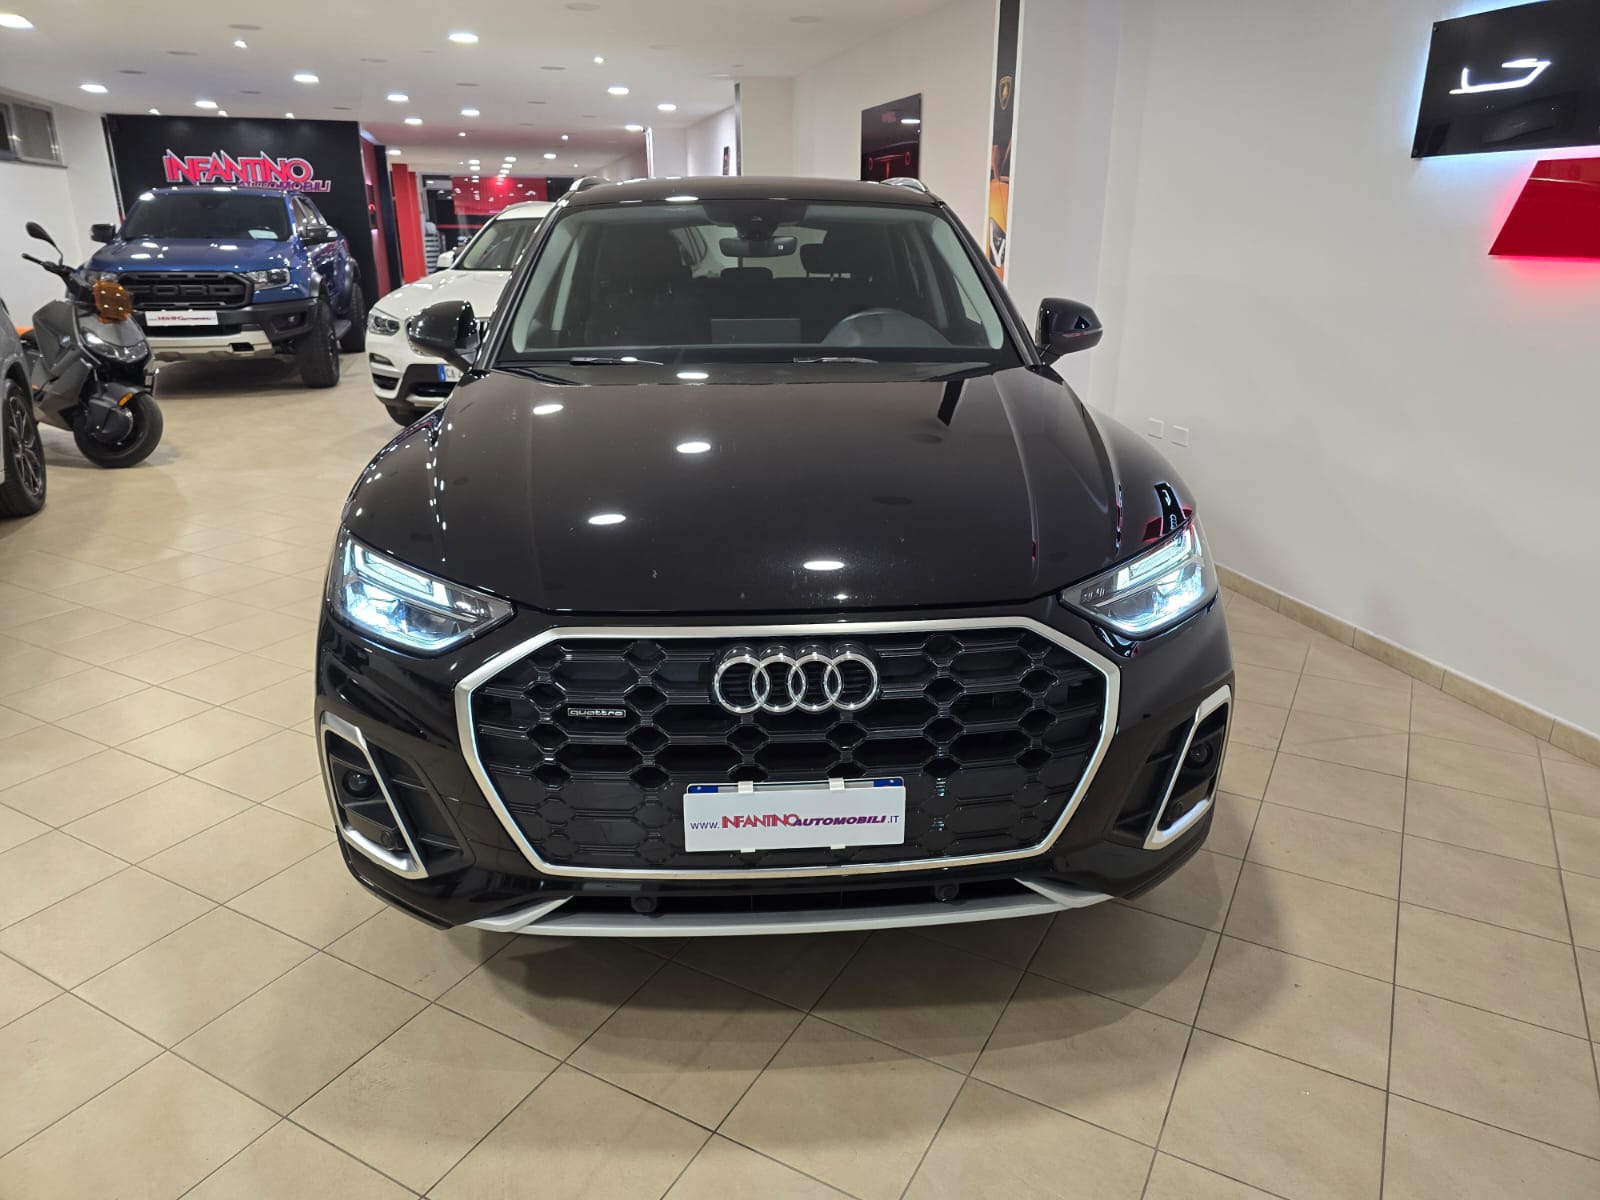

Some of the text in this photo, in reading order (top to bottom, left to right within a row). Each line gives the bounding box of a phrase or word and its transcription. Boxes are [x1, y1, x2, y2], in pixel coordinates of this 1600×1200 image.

[163, 149, 313, 184] INFANTINO
[239, 180, 331, 192] AUTOMOBILI
[128, 284, 243, 295] FORD
[569, 709, 624, 717] quattro
